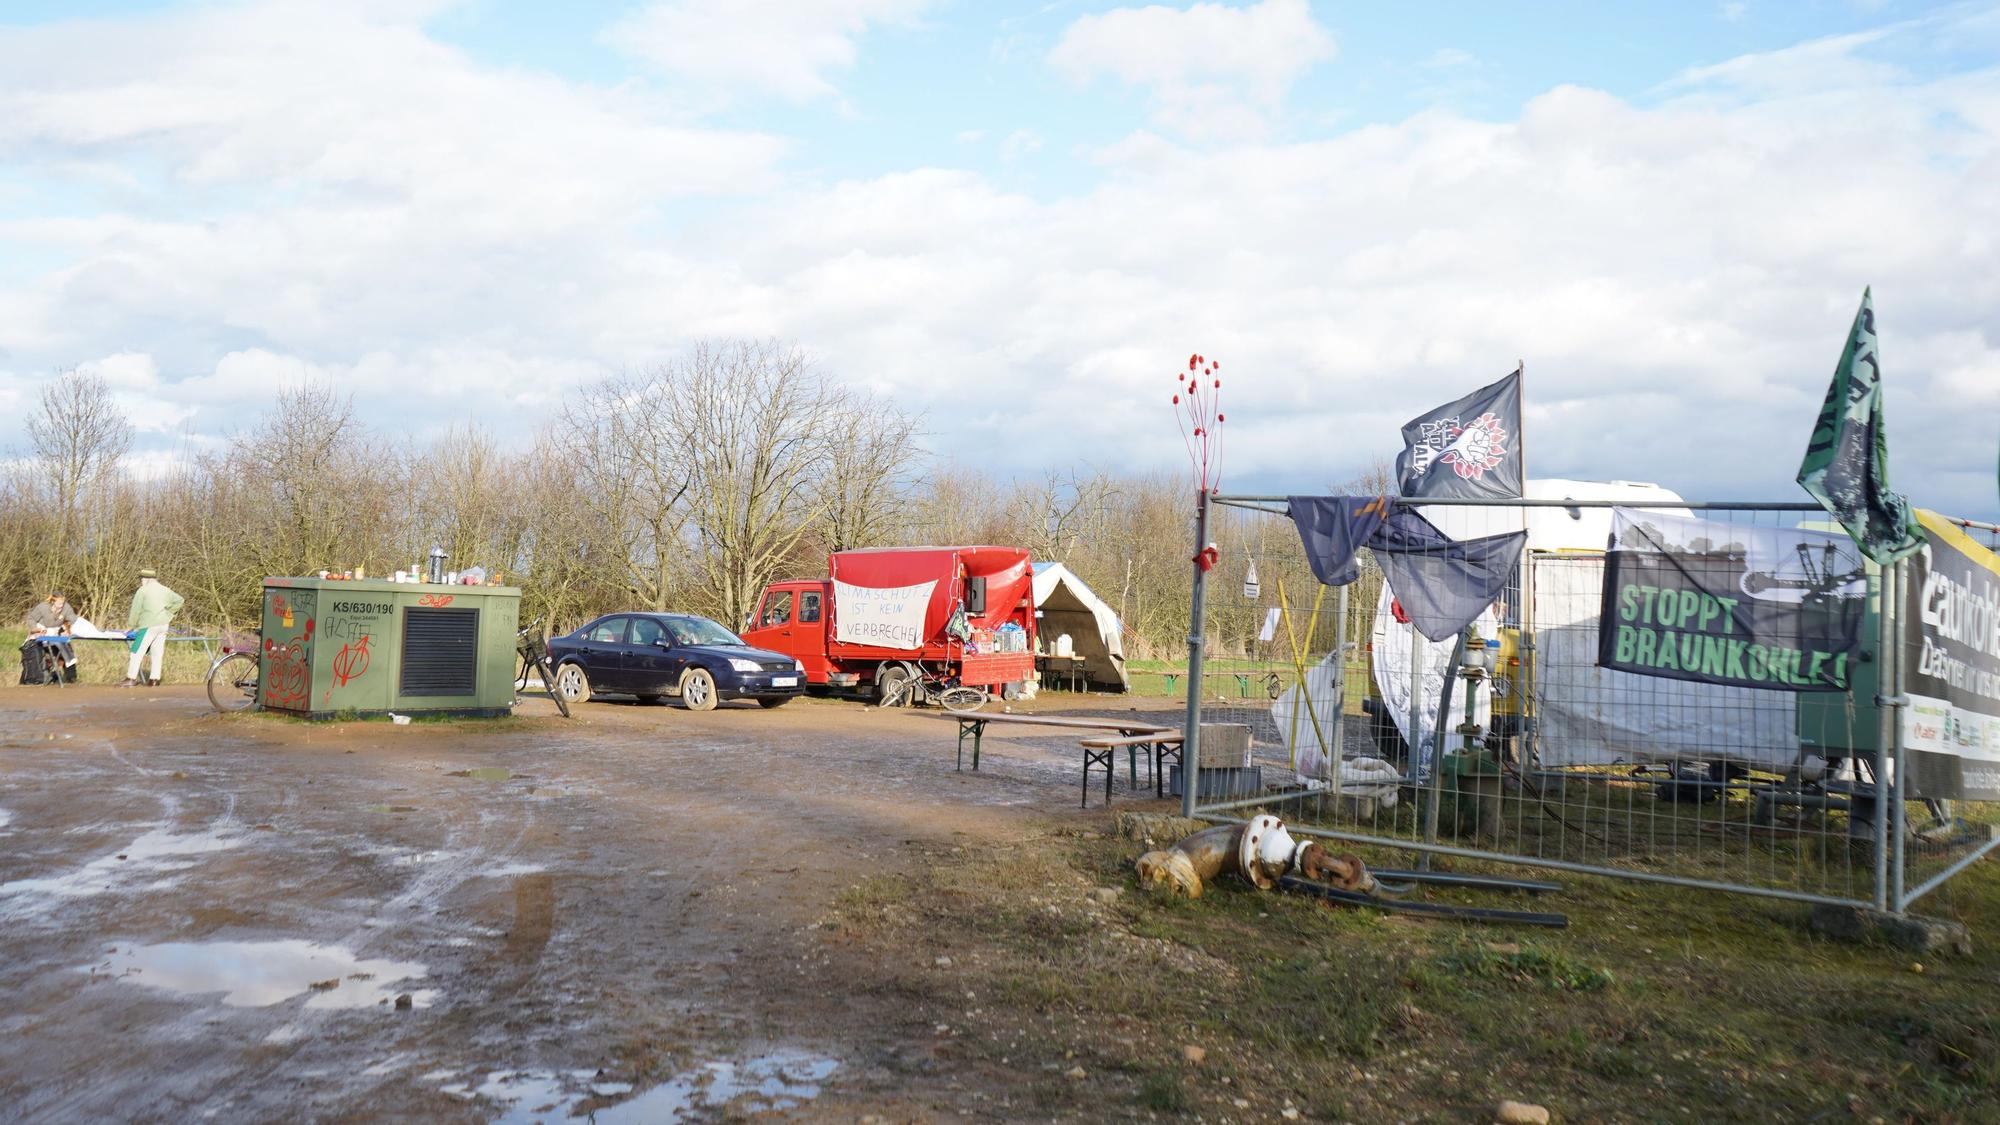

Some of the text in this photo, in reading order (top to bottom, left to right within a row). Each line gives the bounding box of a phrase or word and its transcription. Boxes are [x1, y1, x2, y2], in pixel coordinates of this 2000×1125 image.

[333, 602, 393, 614] KS/630/190
[851, 603, 904, 616] IST KEIN
[1620, 584, 1738, 634] STOPPT
